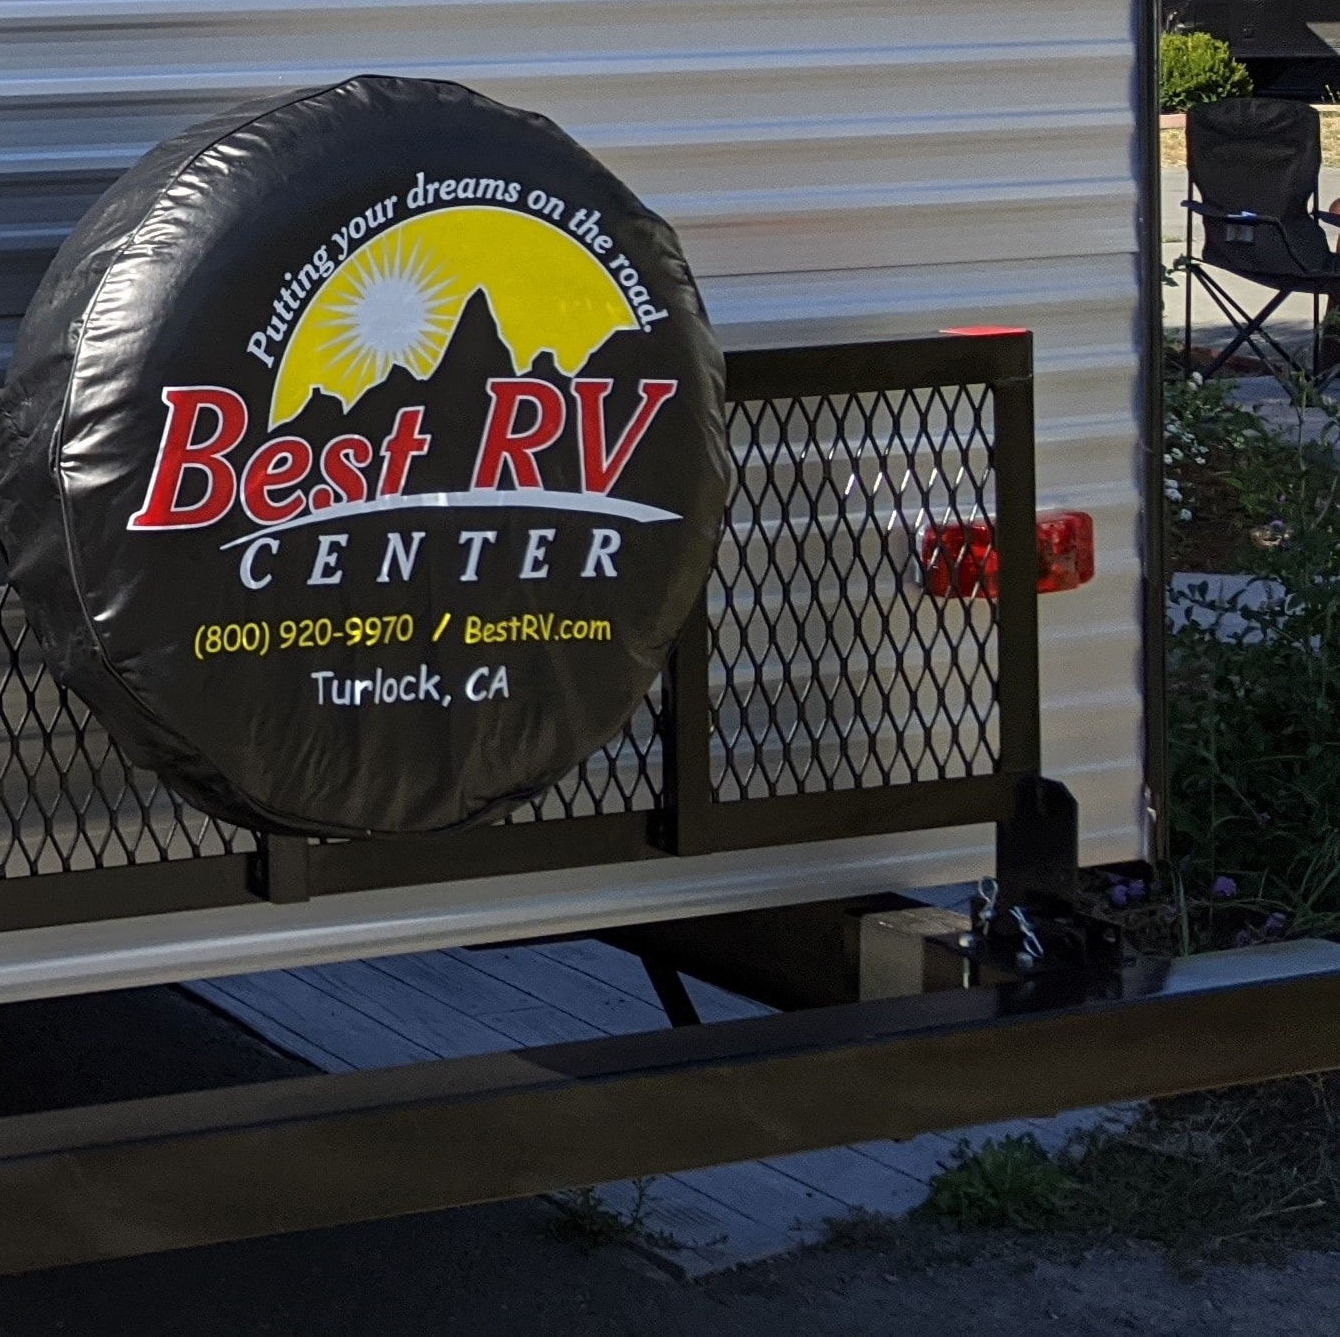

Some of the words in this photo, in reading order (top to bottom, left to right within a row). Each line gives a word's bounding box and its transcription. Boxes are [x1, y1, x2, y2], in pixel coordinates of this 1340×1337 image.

[246, 244, 335, 368] Putting
[331, 195, 398, 261] your
[406, 172, 521, 209] dreams
[527, 189, 566, 220] on
[568, 208, 613, 254] the
[609, 253, 669, 333] road.
[126, 385, 431, 531] Best
[471, 377, 678, 496] RV
[239, 528, 621, 589] CENTER
[194, 624, 270, 660] (800)
[279, 614, 414, 650] 920-9970
[464, 613, 612, 644] BestRV.com
[311, 664, 452, 707] Turlock,
[465, 666, 510, 701] CA
